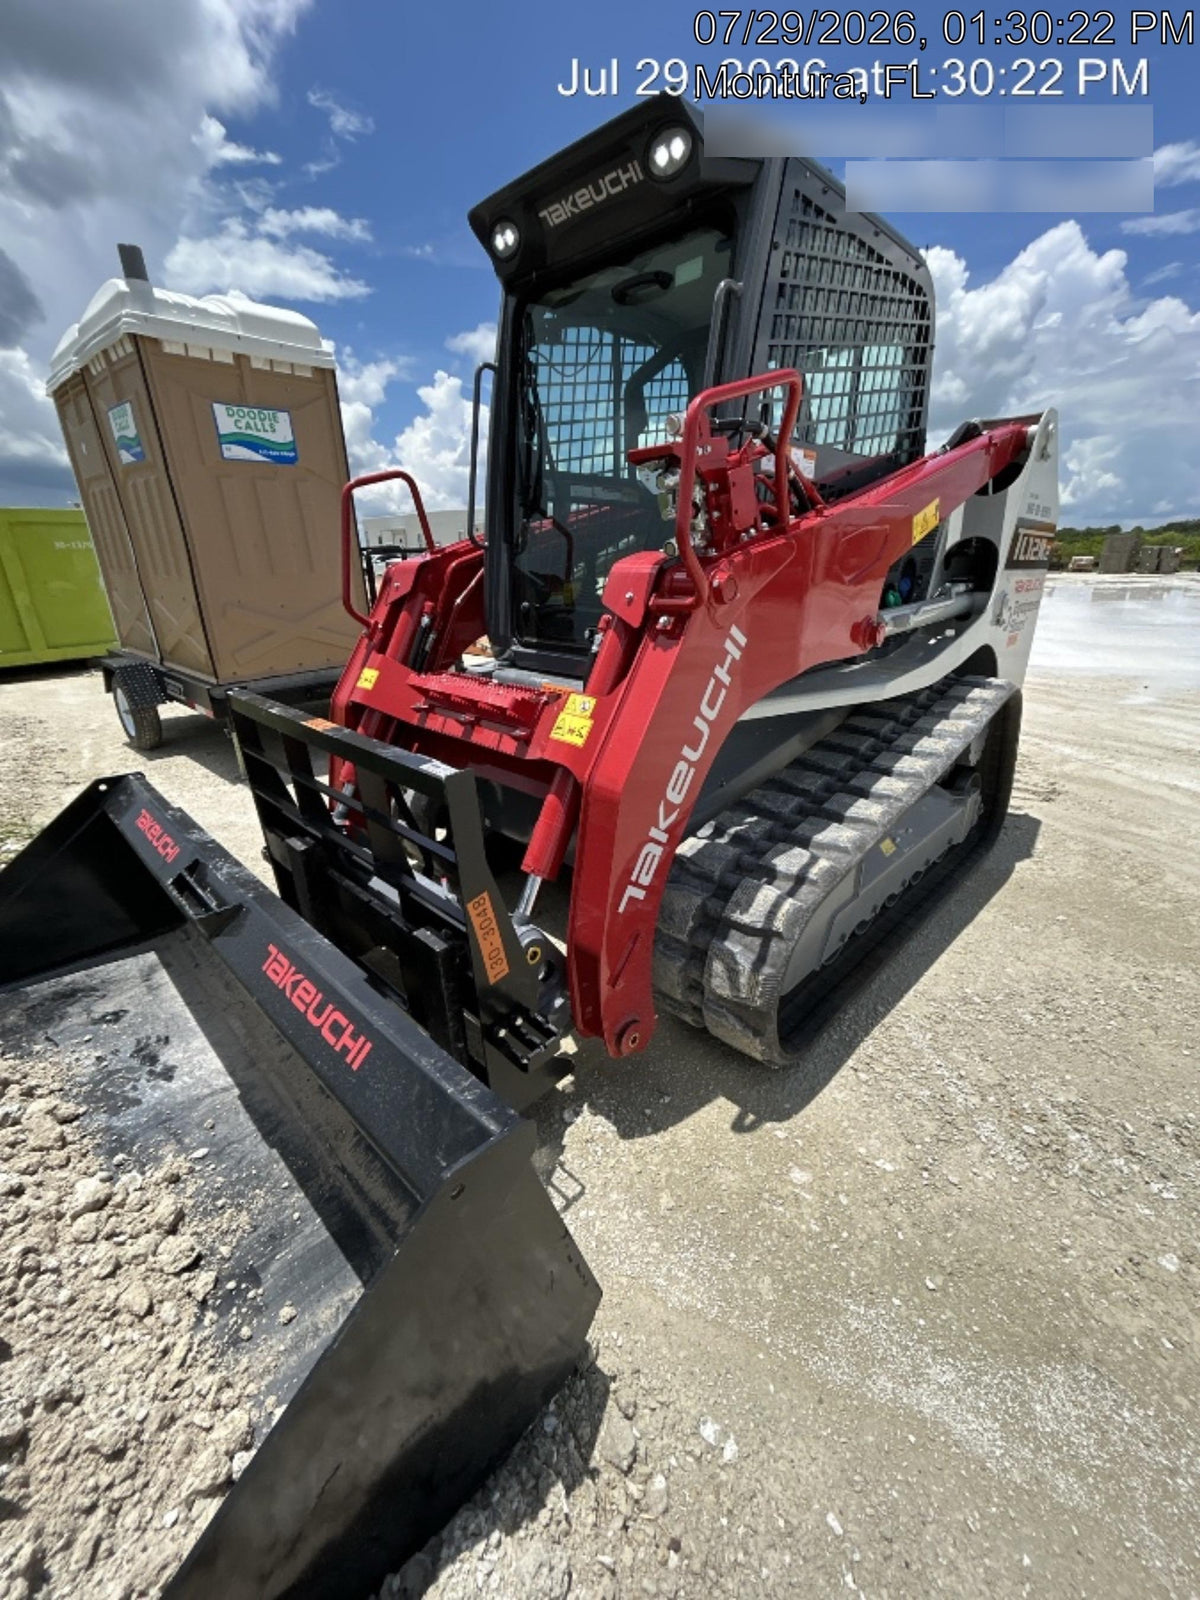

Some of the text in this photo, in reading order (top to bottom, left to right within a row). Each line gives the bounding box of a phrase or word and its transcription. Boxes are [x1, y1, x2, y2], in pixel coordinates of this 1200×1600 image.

[225, 406, 281, 424] DOODIE
[234, 418, 277, 433] CALLS
[472, 896, 508, 979] 130-3048
